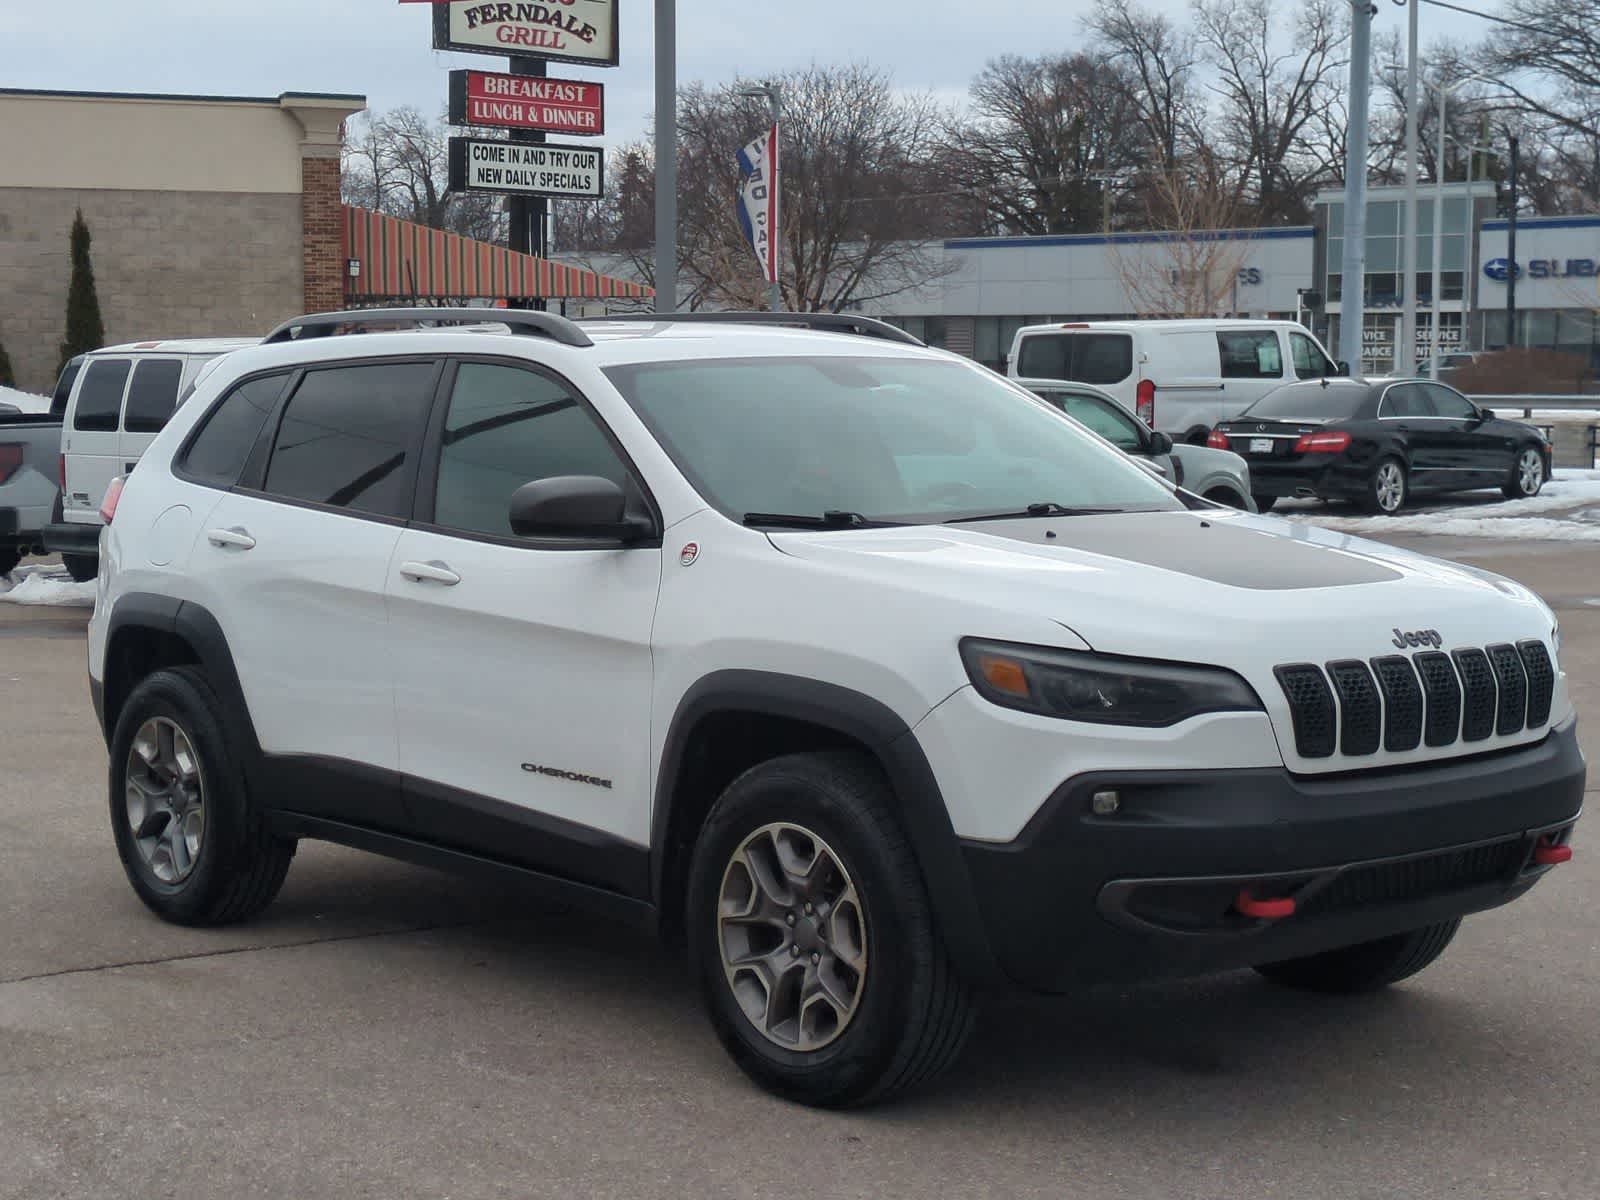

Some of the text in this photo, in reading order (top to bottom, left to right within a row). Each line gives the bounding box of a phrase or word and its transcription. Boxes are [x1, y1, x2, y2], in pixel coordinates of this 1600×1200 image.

[464, 4, 597, 43] FERNDALE
[496, 24, 567, 49] GRILL
[484, 76, 588, 102] BREAKFAST
[474, 101, 596, 127] LUNCH & DINNER
[473, 145, 596, 169] COME IN AND TRY OUR
[477, 167, 591, 190] NEW DAILY SPECIALS
[1528, 258, 1600, 278] SUB
[1392, 628, 1442, 649] Jeep
[520, 763, 612, 789] CHEROKEE
